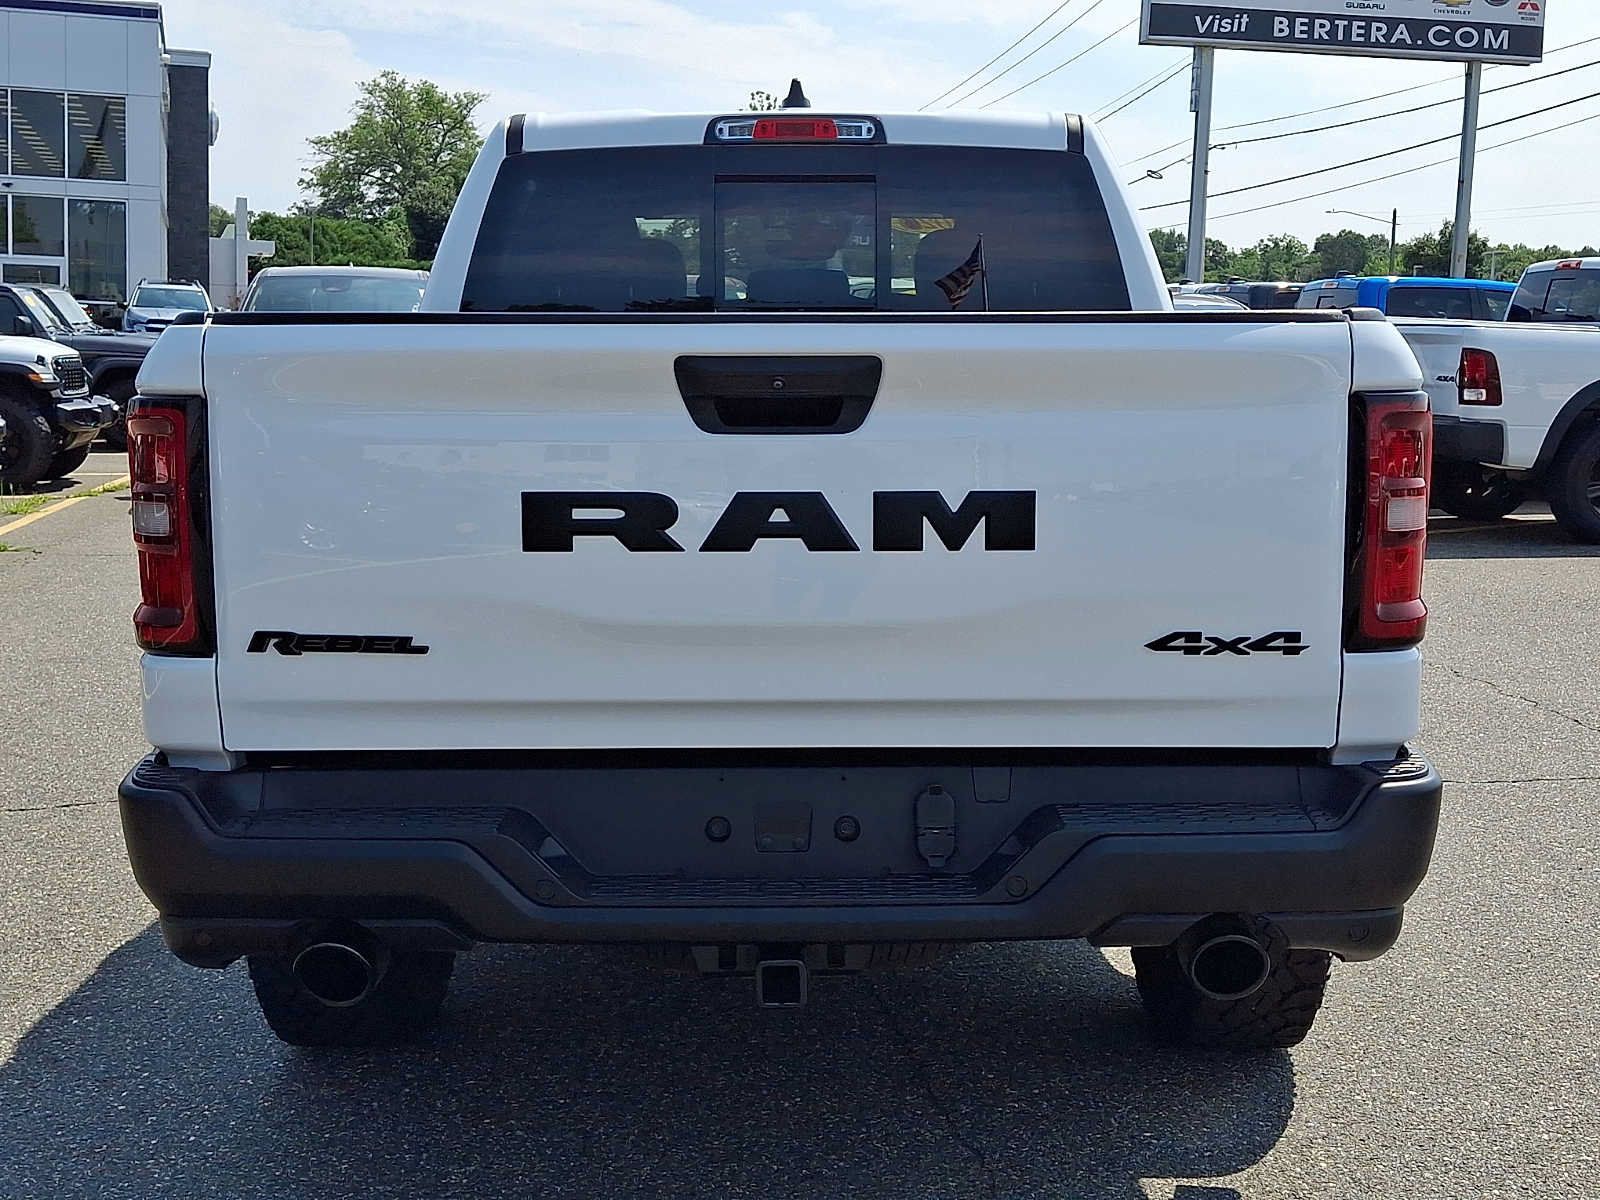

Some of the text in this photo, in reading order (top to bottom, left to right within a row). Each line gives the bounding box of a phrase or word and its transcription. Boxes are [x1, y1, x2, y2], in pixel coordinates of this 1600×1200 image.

[1345, 2, 1386, 10] SUBARU
[1195, 14, 1509, 50] Visit BERTERA.COM
[521, 490, 1037, 552] RAM
[247, 630, 430, 656] REBEL
[1144, 631, 1311, 656] 4x4
